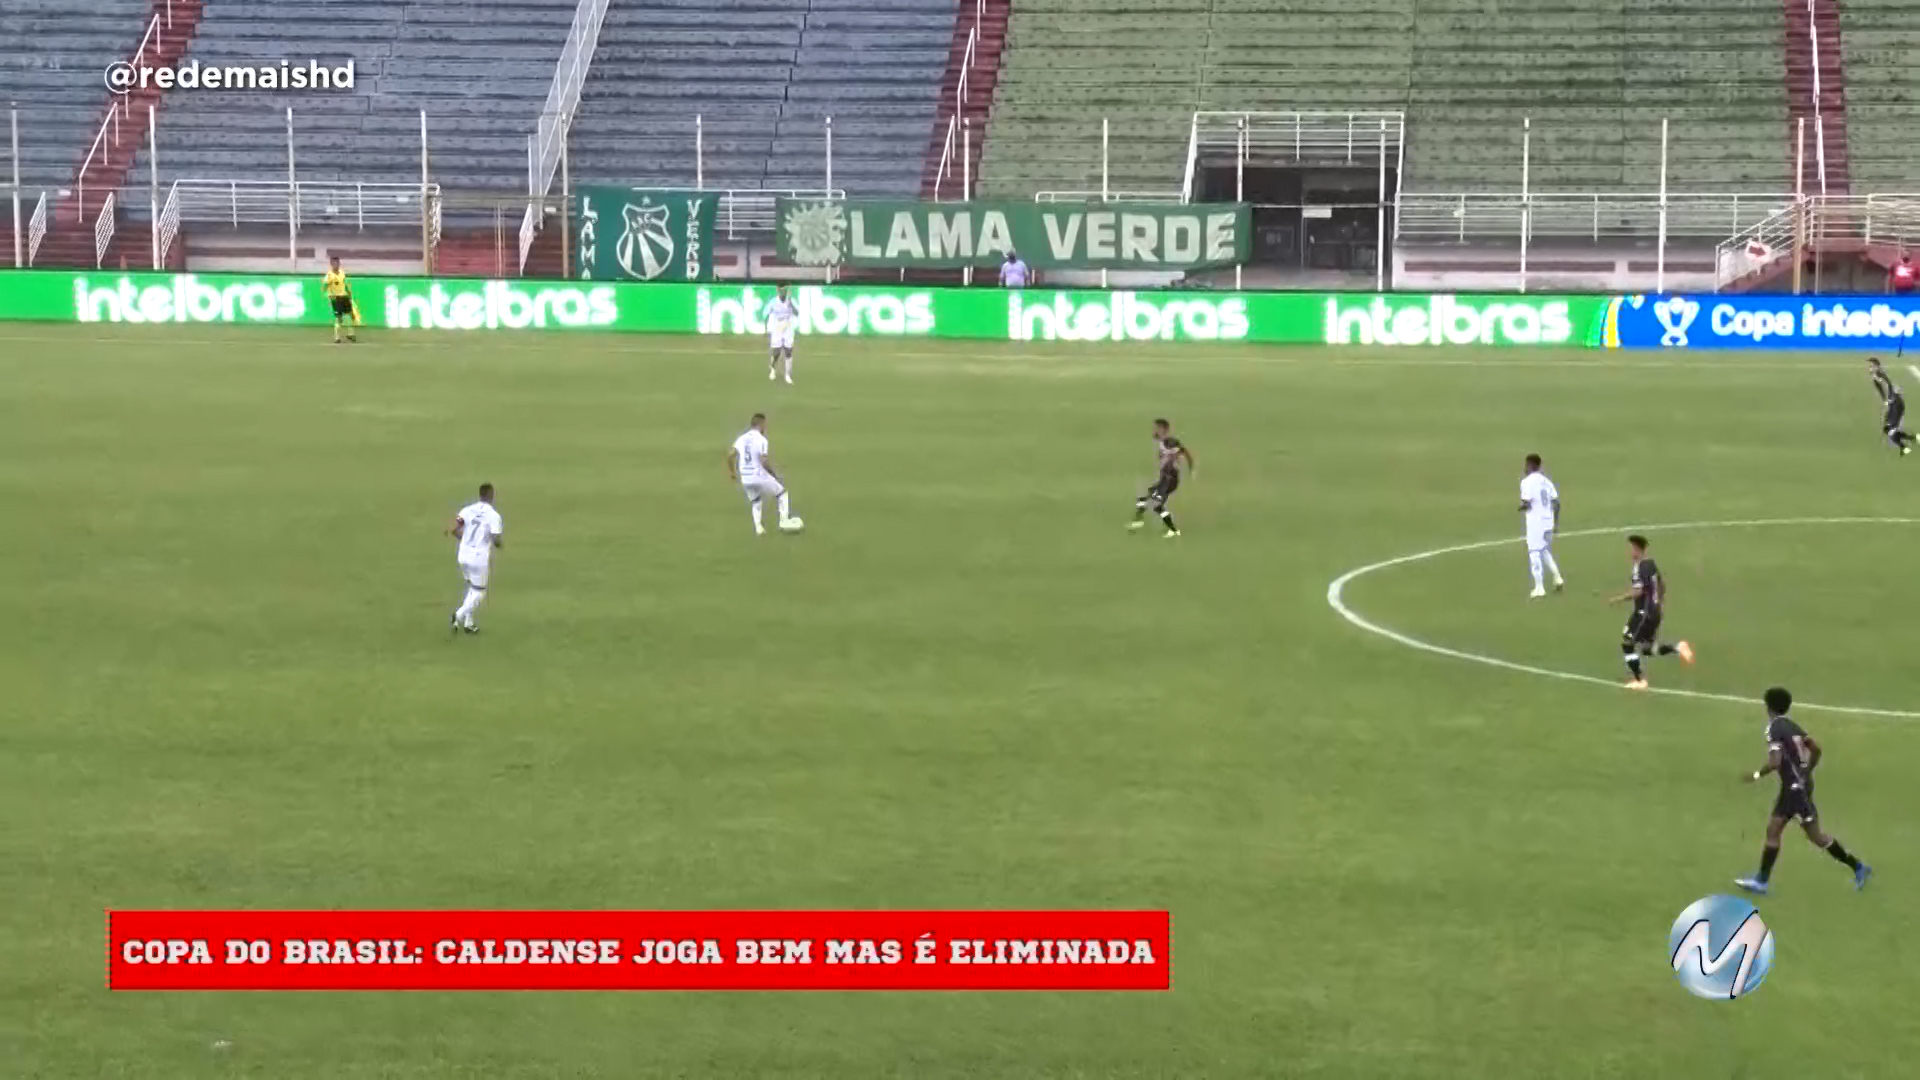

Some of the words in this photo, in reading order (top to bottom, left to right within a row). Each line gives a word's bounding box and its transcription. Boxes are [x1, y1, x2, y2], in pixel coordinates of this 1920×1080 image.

[850, 211, 1013, 259] LAMA
[1042, 211, 1236, 262] VERDE
[73, 276, 306, 323] intelbras
[384, 280, 618, 330] intelbras
[697, 286, 936, 334] intlbras
[1008, 290, 1249, 341] intelbras
[1325, 294, 1573, 347] intelbras
[1712, 303, 1795, 342] Copa
[469, 518, 481, 545] 7
